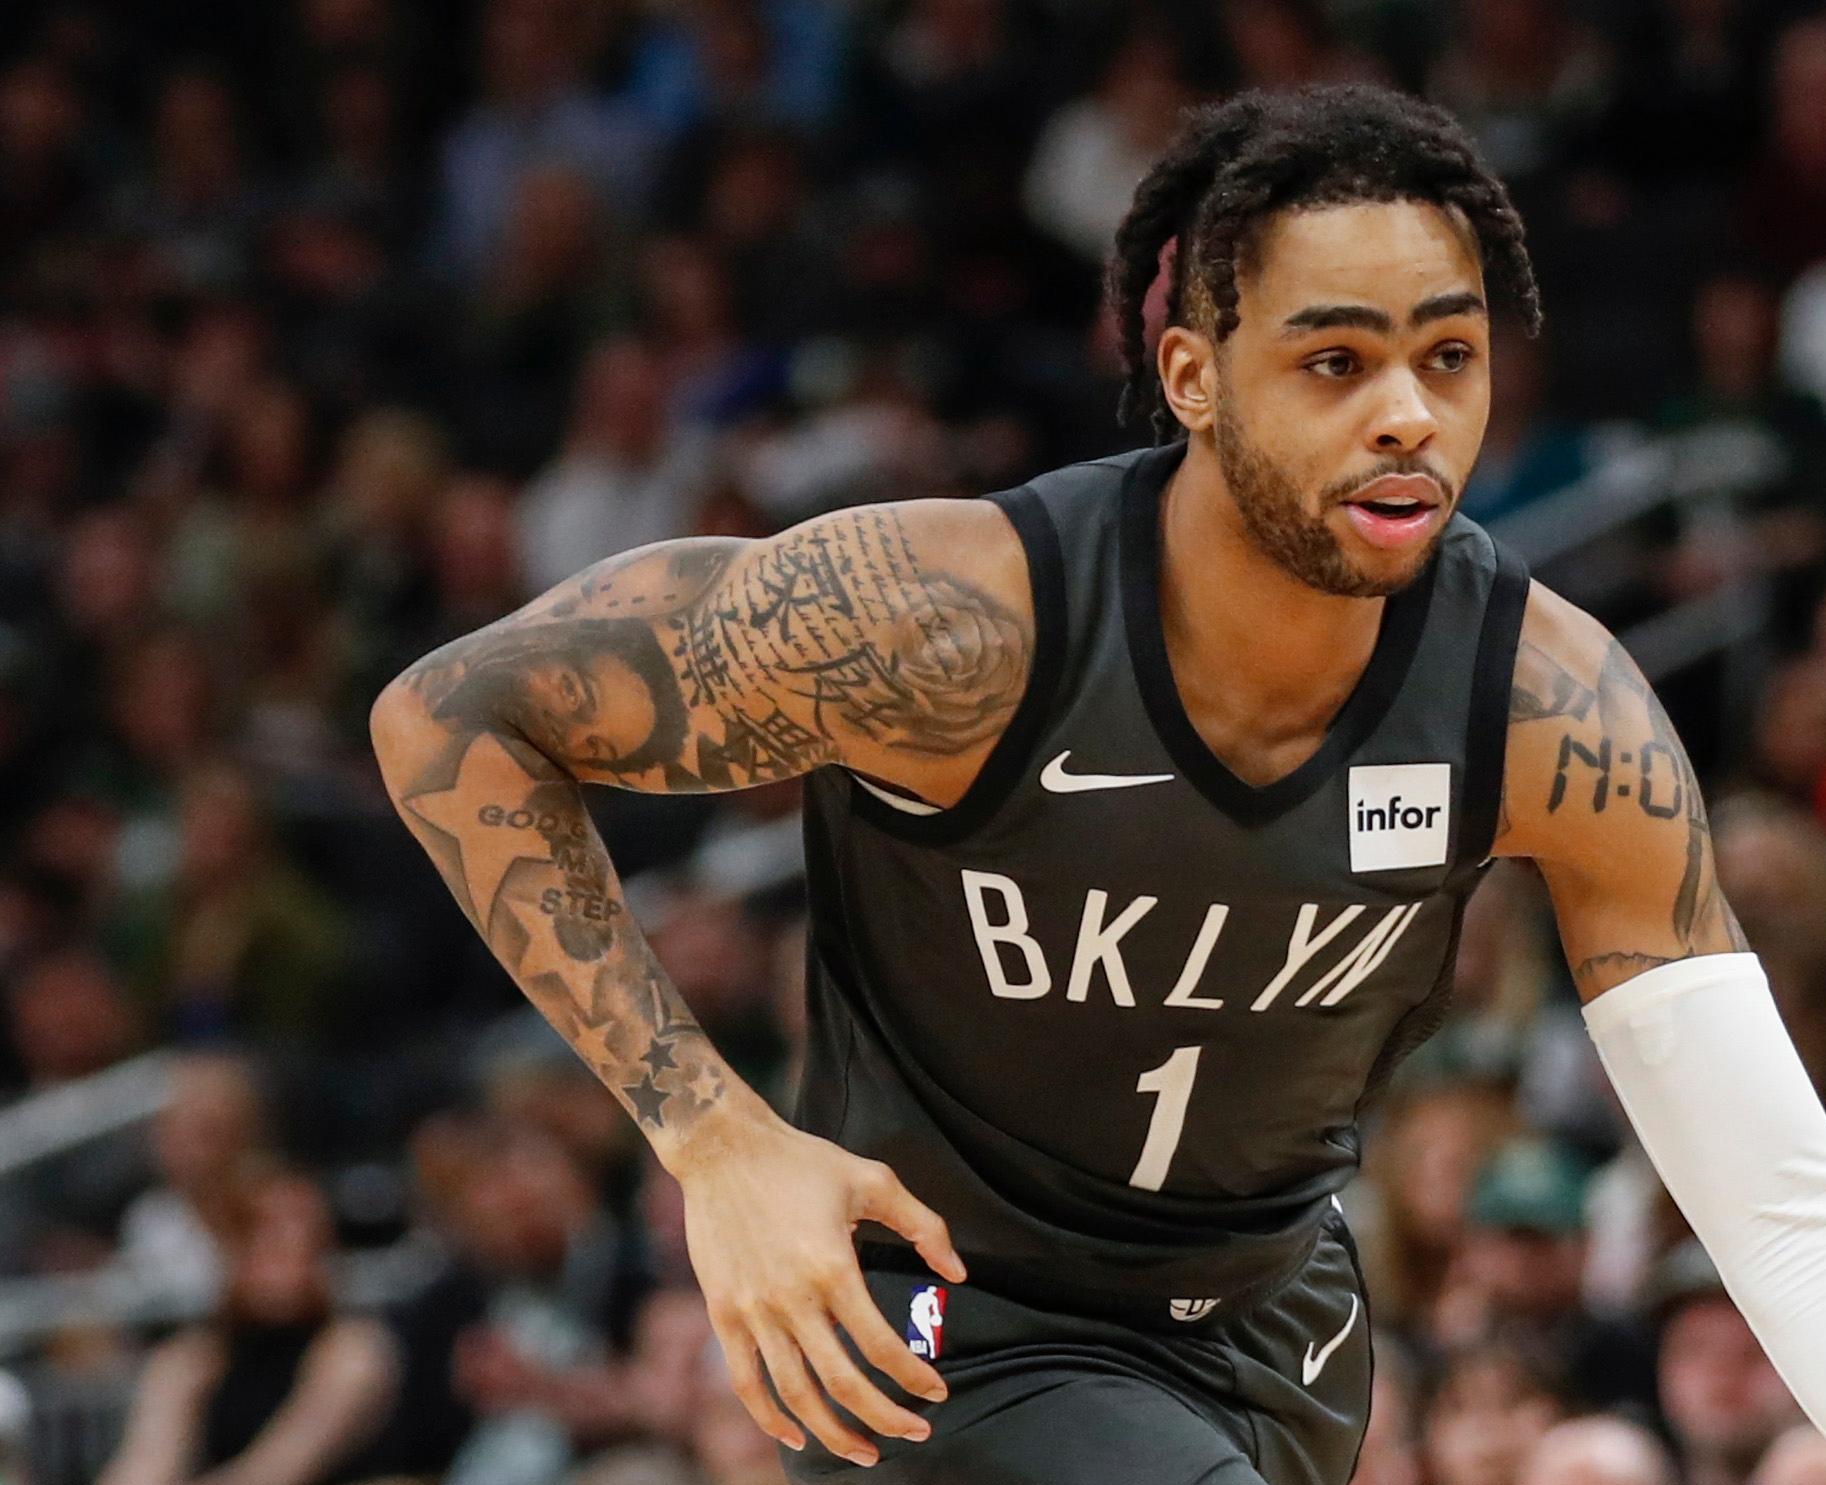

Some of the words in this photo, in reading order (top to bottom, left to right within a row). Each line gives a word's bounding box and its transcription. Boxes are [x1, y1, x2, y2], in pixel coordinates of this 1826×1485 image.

[1357, 796, 1441, 832] infor
[540, 887, 622, 922] STEP
[961, 869, 1422, 1012] BKLYN
[1128, 1046, 1202, 1192] 1
